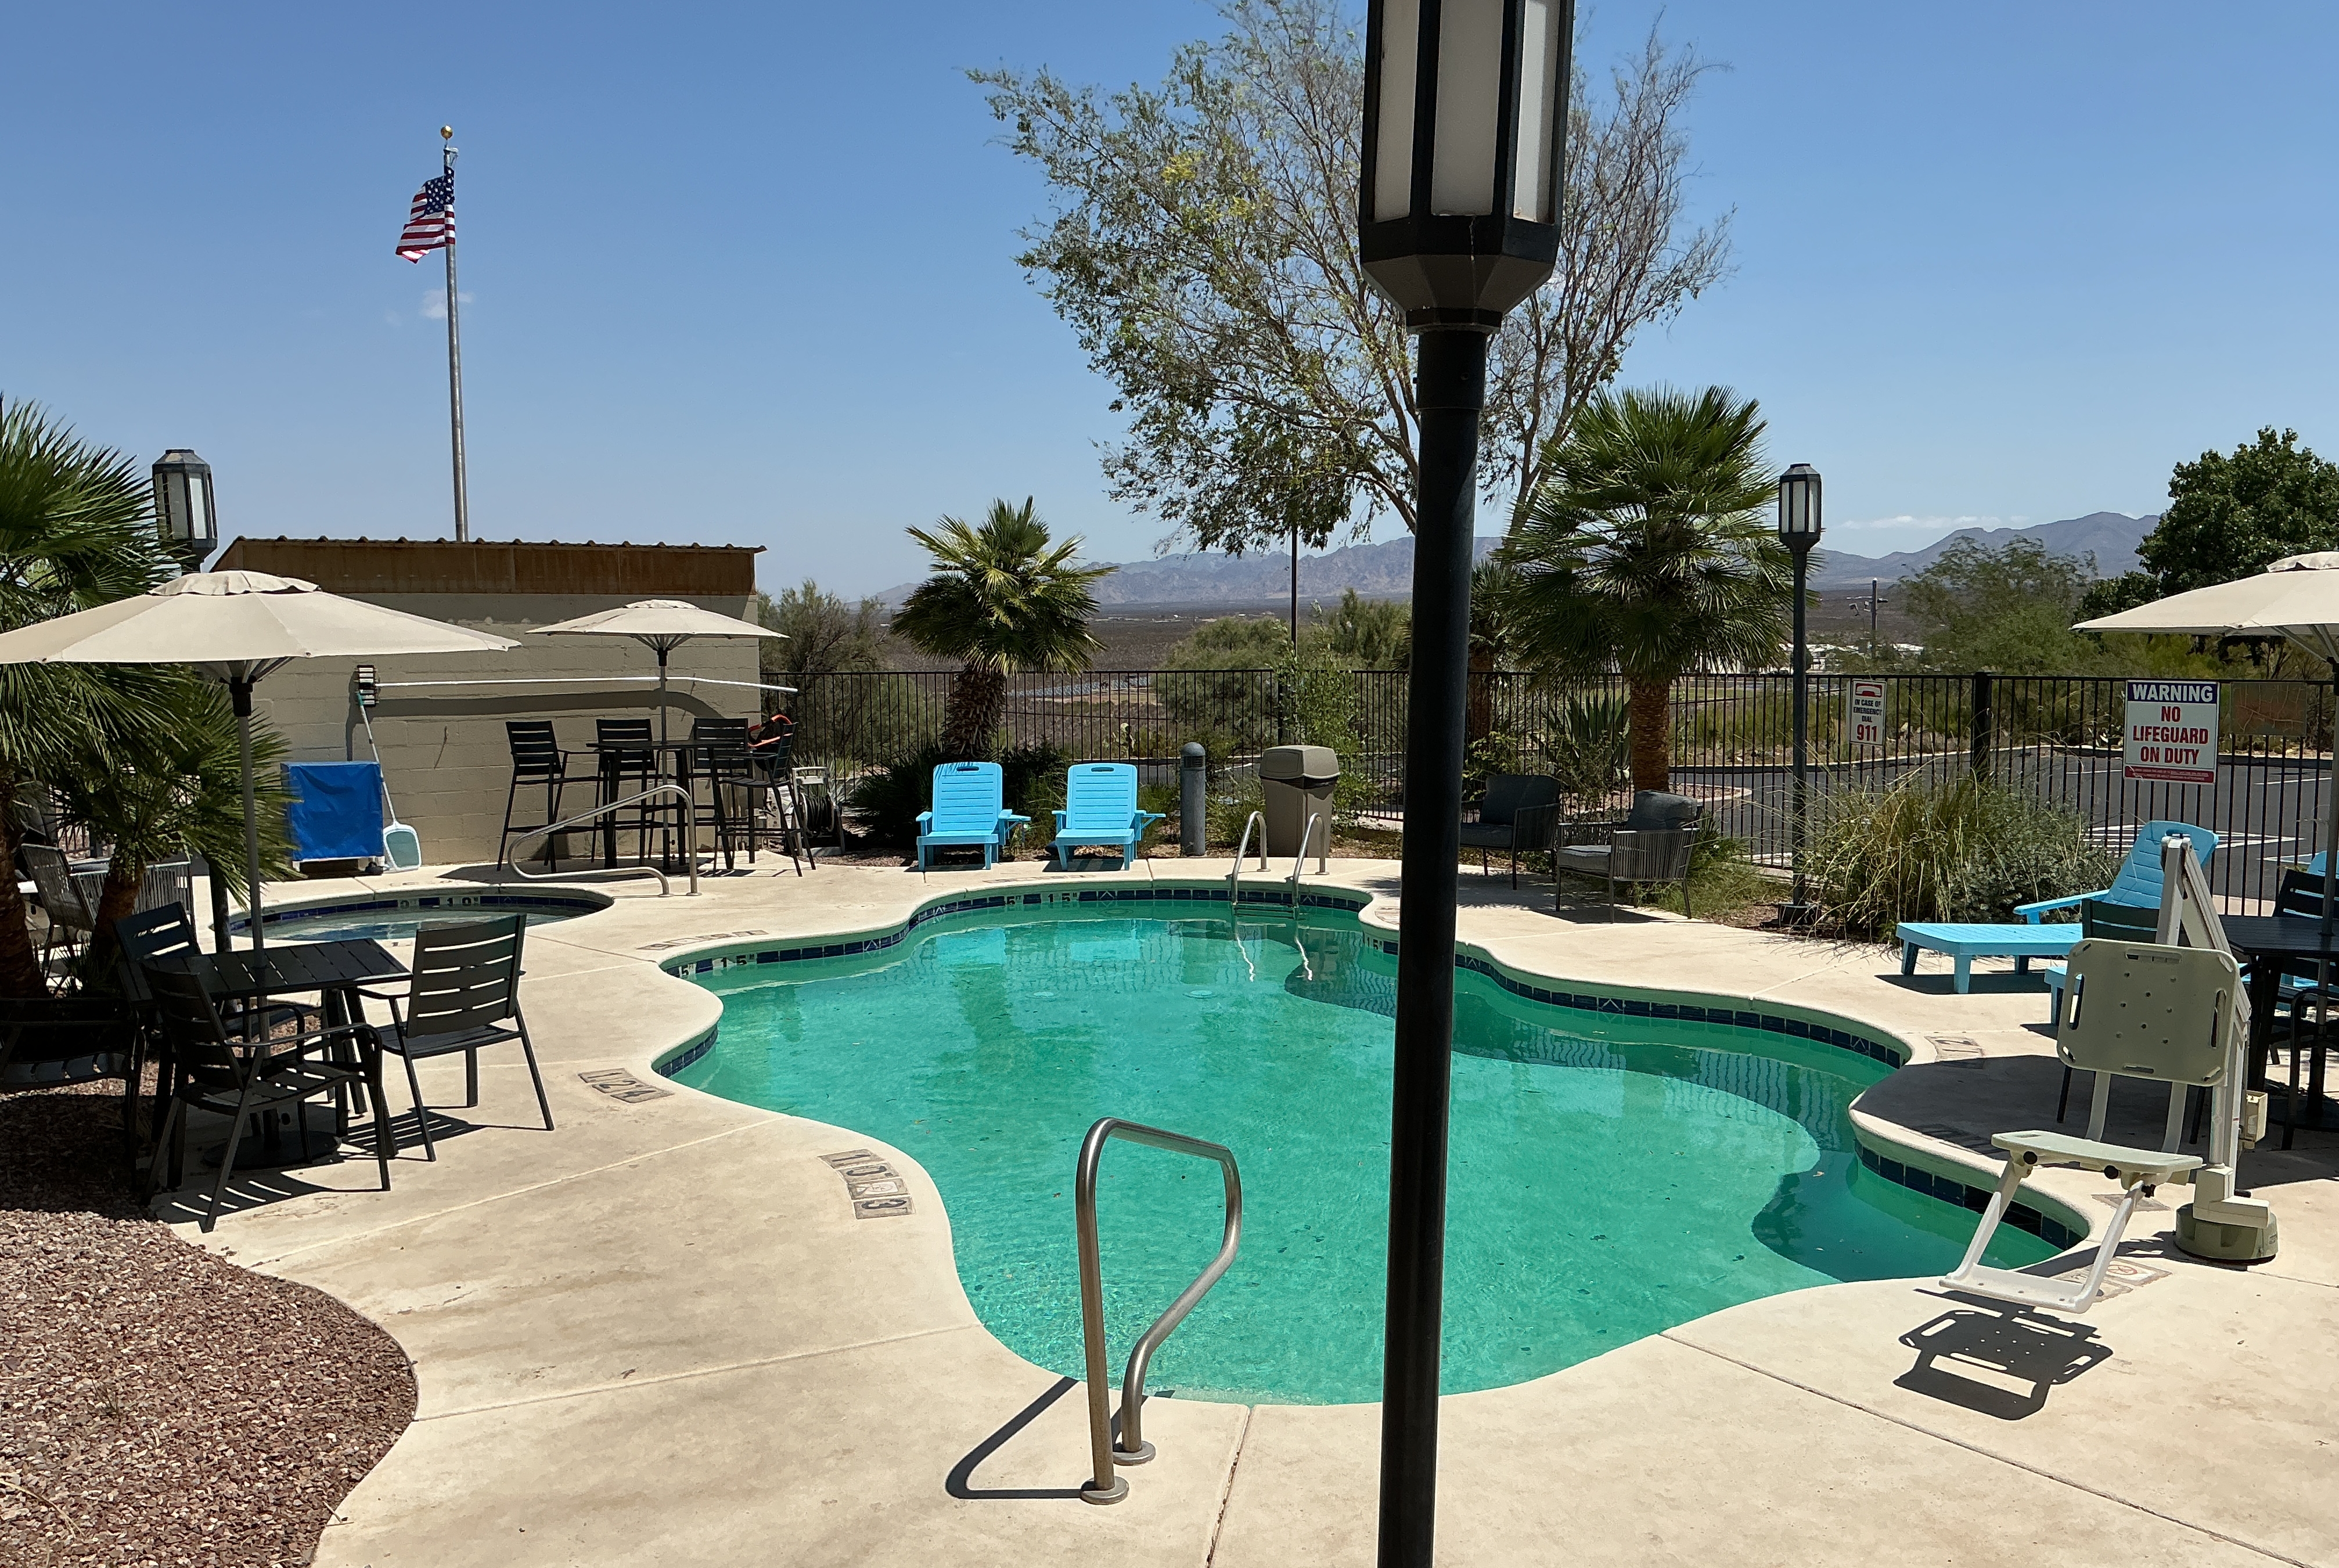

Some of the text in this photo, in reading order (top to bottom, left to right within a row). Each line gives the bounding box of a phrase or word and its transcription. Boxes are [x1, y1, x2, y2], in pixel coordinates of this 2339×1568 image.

[2132, 684, 2213, 702] WARNING
[1854, 707, 1883, 715] EMERGENCY
[2161, 706, 2181, 722] NO
[1857, 724, 1877, 742] 911
[2133, 725, 2208, 744] LIFEGUARD
[2140, 746, 2200, 765] ON DUTY
